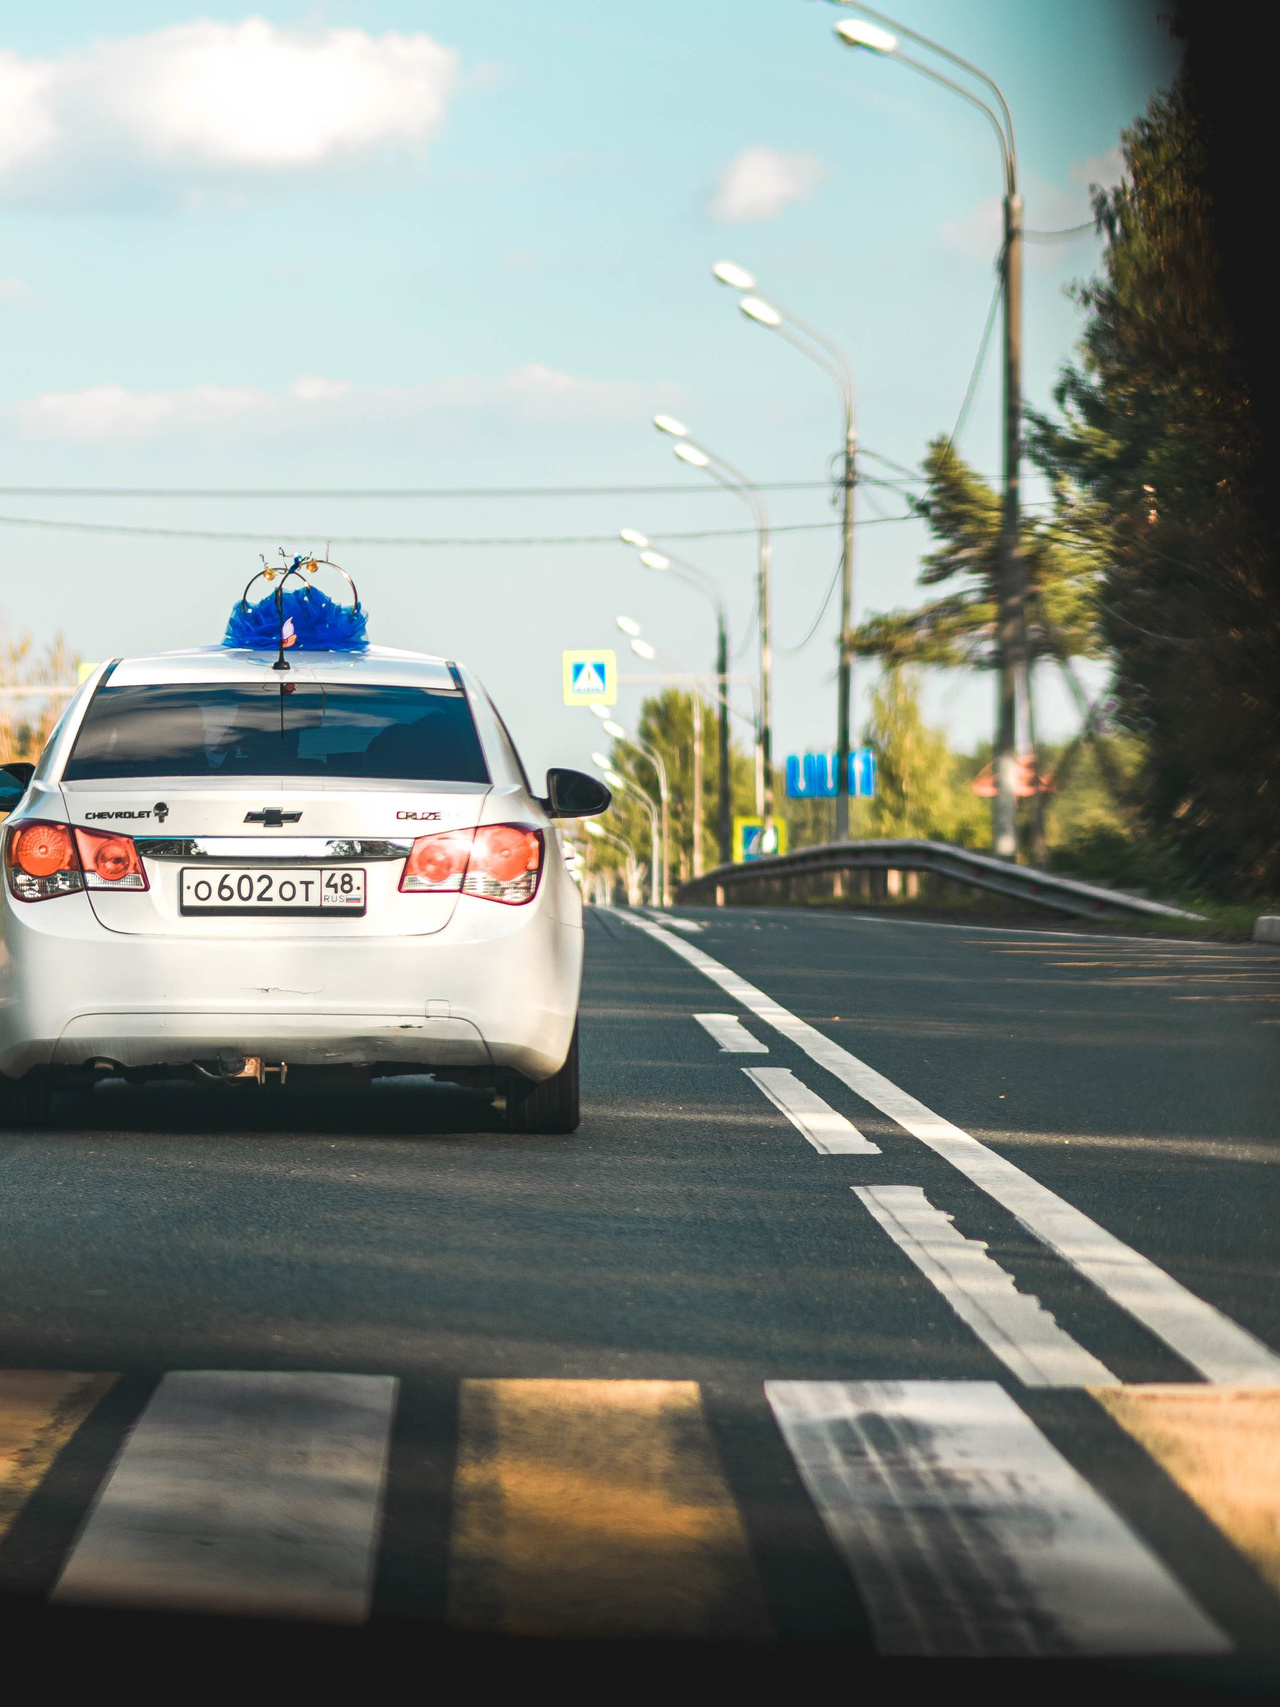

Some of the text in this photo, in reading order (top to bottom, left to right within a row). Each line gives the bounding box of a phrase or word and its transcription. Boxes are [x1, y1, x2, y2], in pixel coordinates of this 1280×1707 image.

[85, 811, 152, 820] CHEVROLET
[396, 811, 441, 821] CRUZE
[325, 872, 354, 894] 48
[323, 894, 345, 903] RUS
